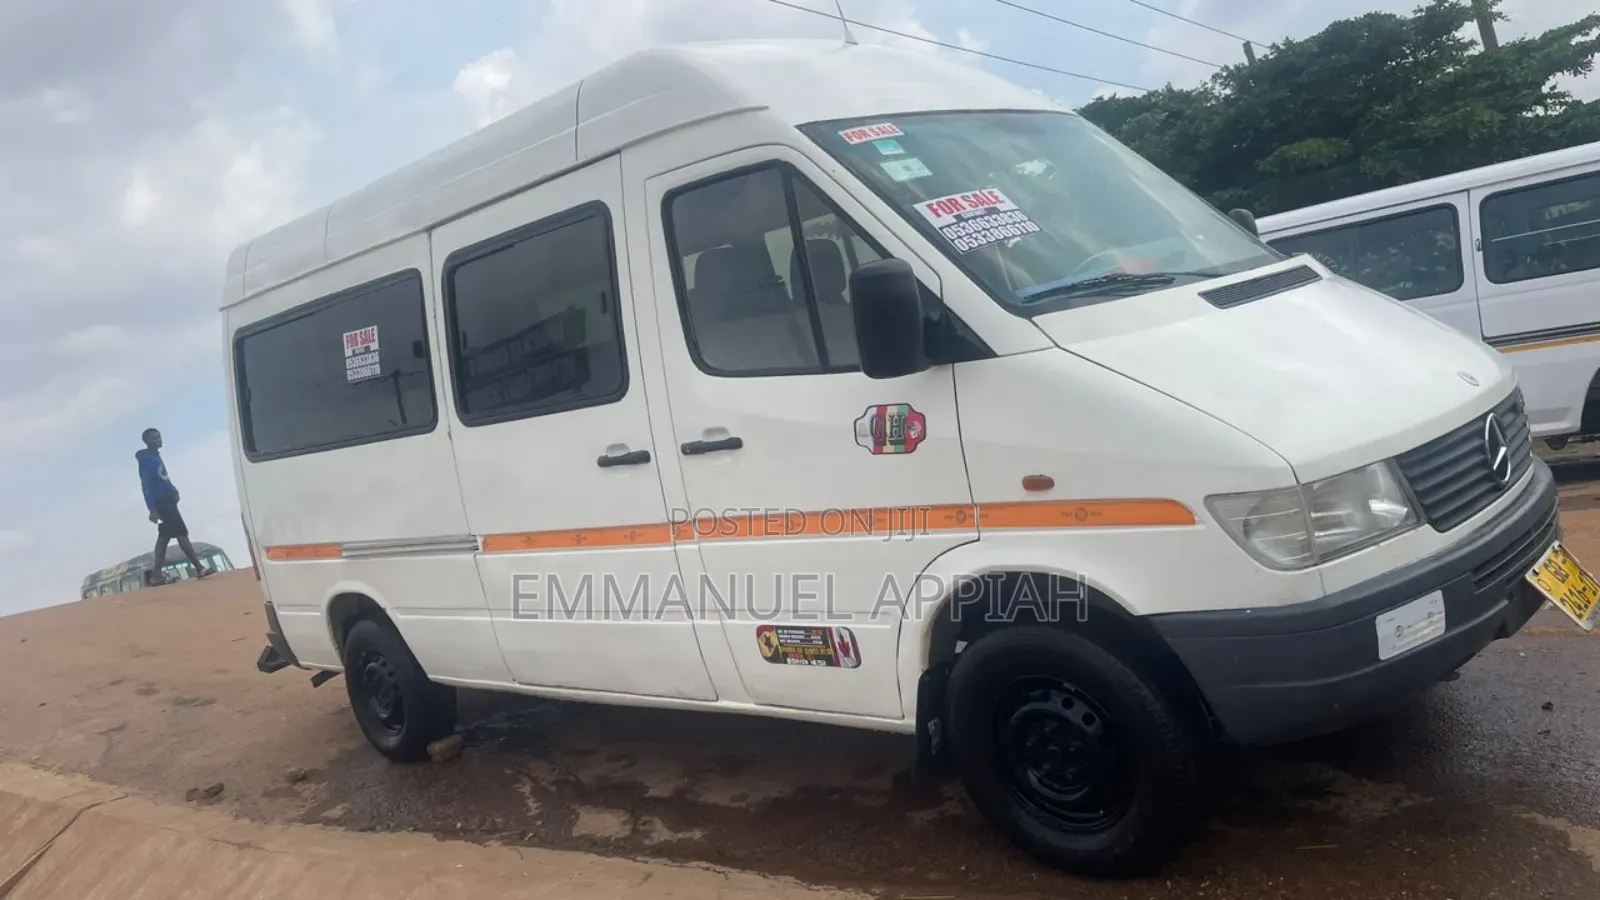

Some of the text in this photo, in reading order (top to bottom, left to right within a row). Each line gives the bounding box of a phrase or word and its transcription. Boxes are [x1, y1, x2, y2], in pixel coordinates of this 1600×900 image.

[926, 190, 1006, 218] FOR SALE
[345, 333, 359, 350] FOR
[360, 328, 376, 346] SALE
